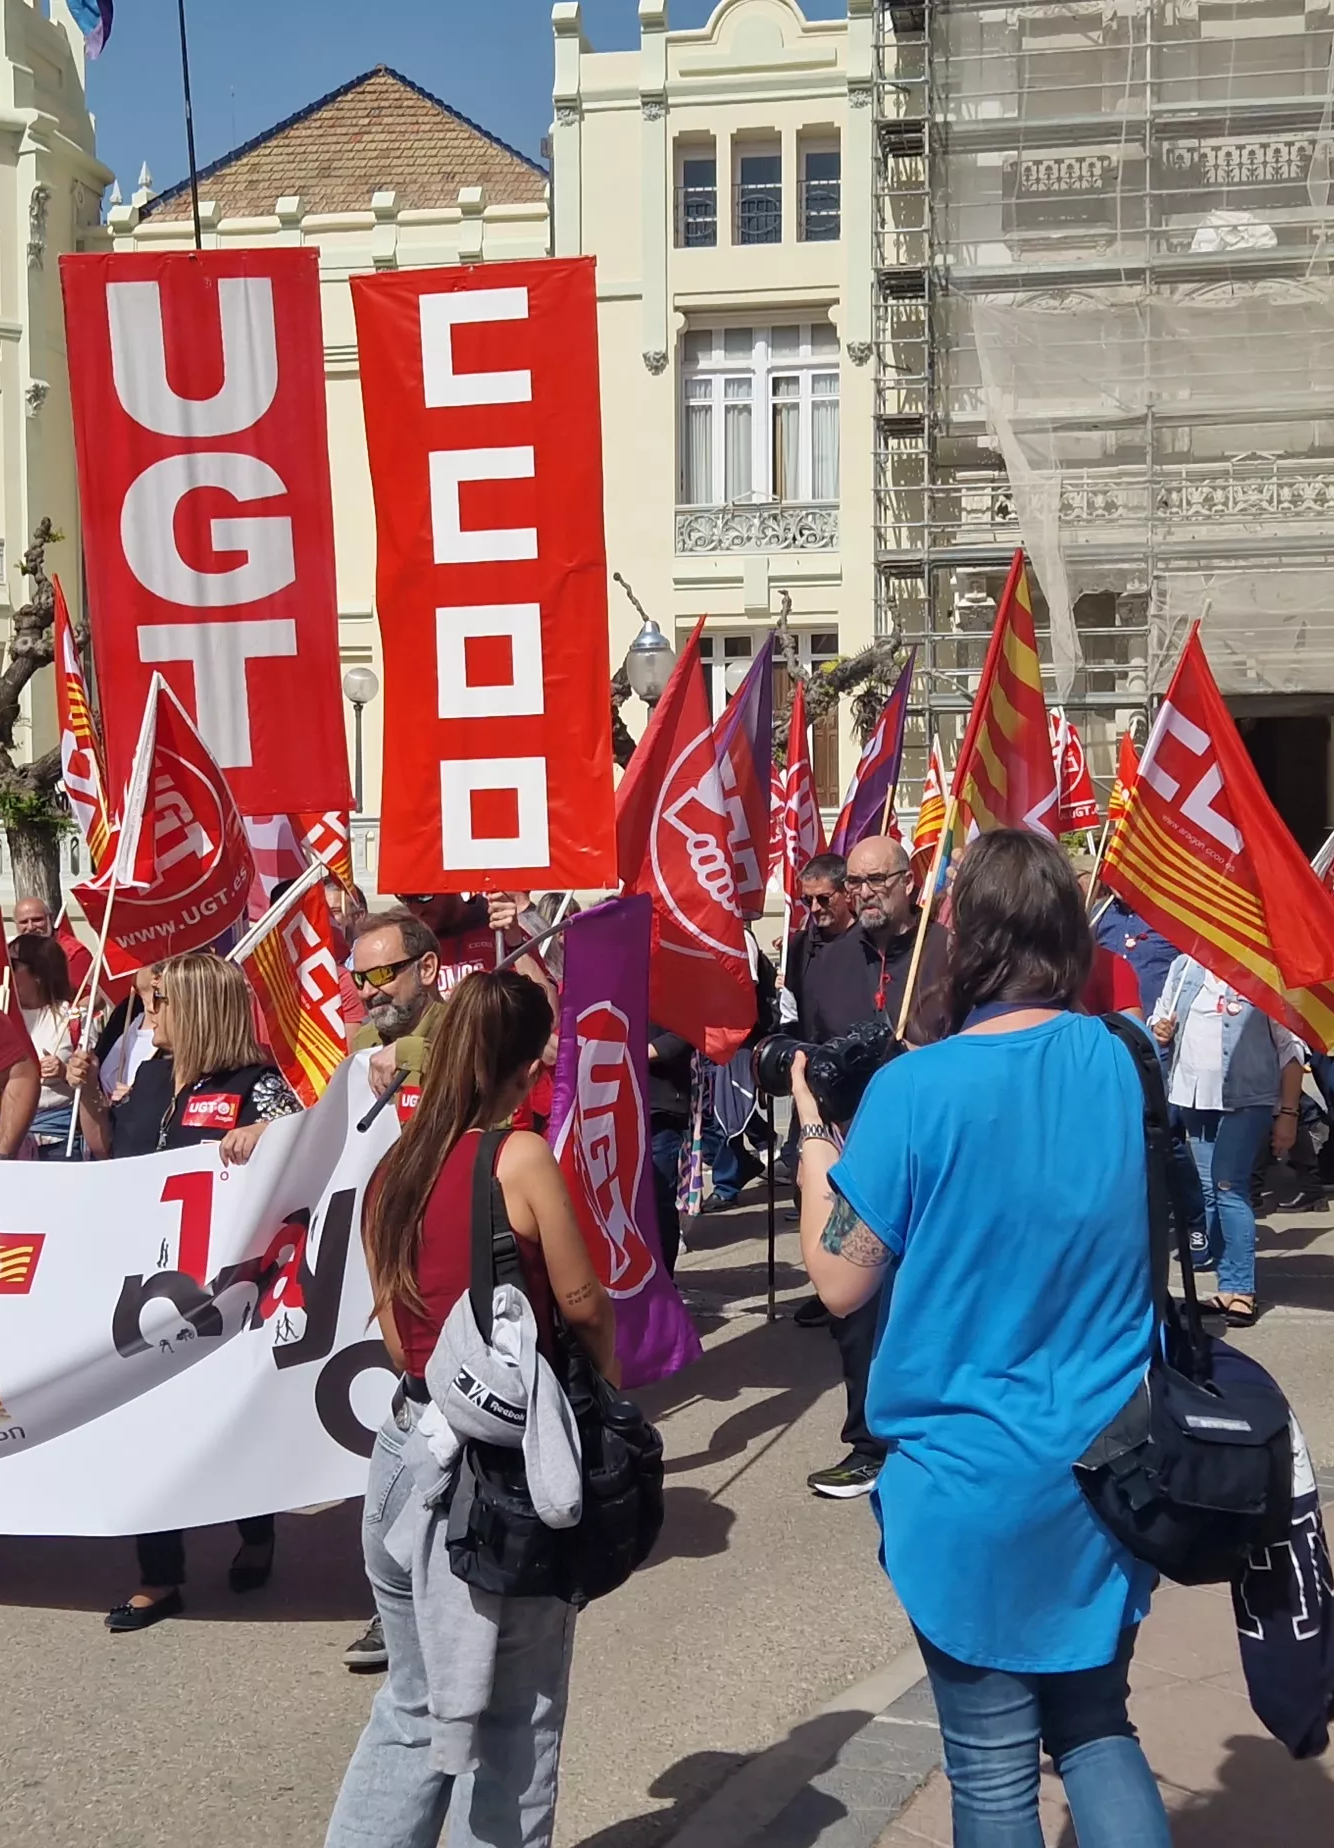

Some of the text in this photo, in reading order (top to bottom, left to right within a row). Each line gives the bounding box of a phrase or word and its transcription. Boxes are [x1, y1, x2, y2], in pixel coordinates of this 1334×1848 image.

[106, 277, 297, 768] UGT
[419, 287, 550, 871] CCOO
[189, 1101, 217, 1114] UGT
[401, 1093, 420, 1108] UG
